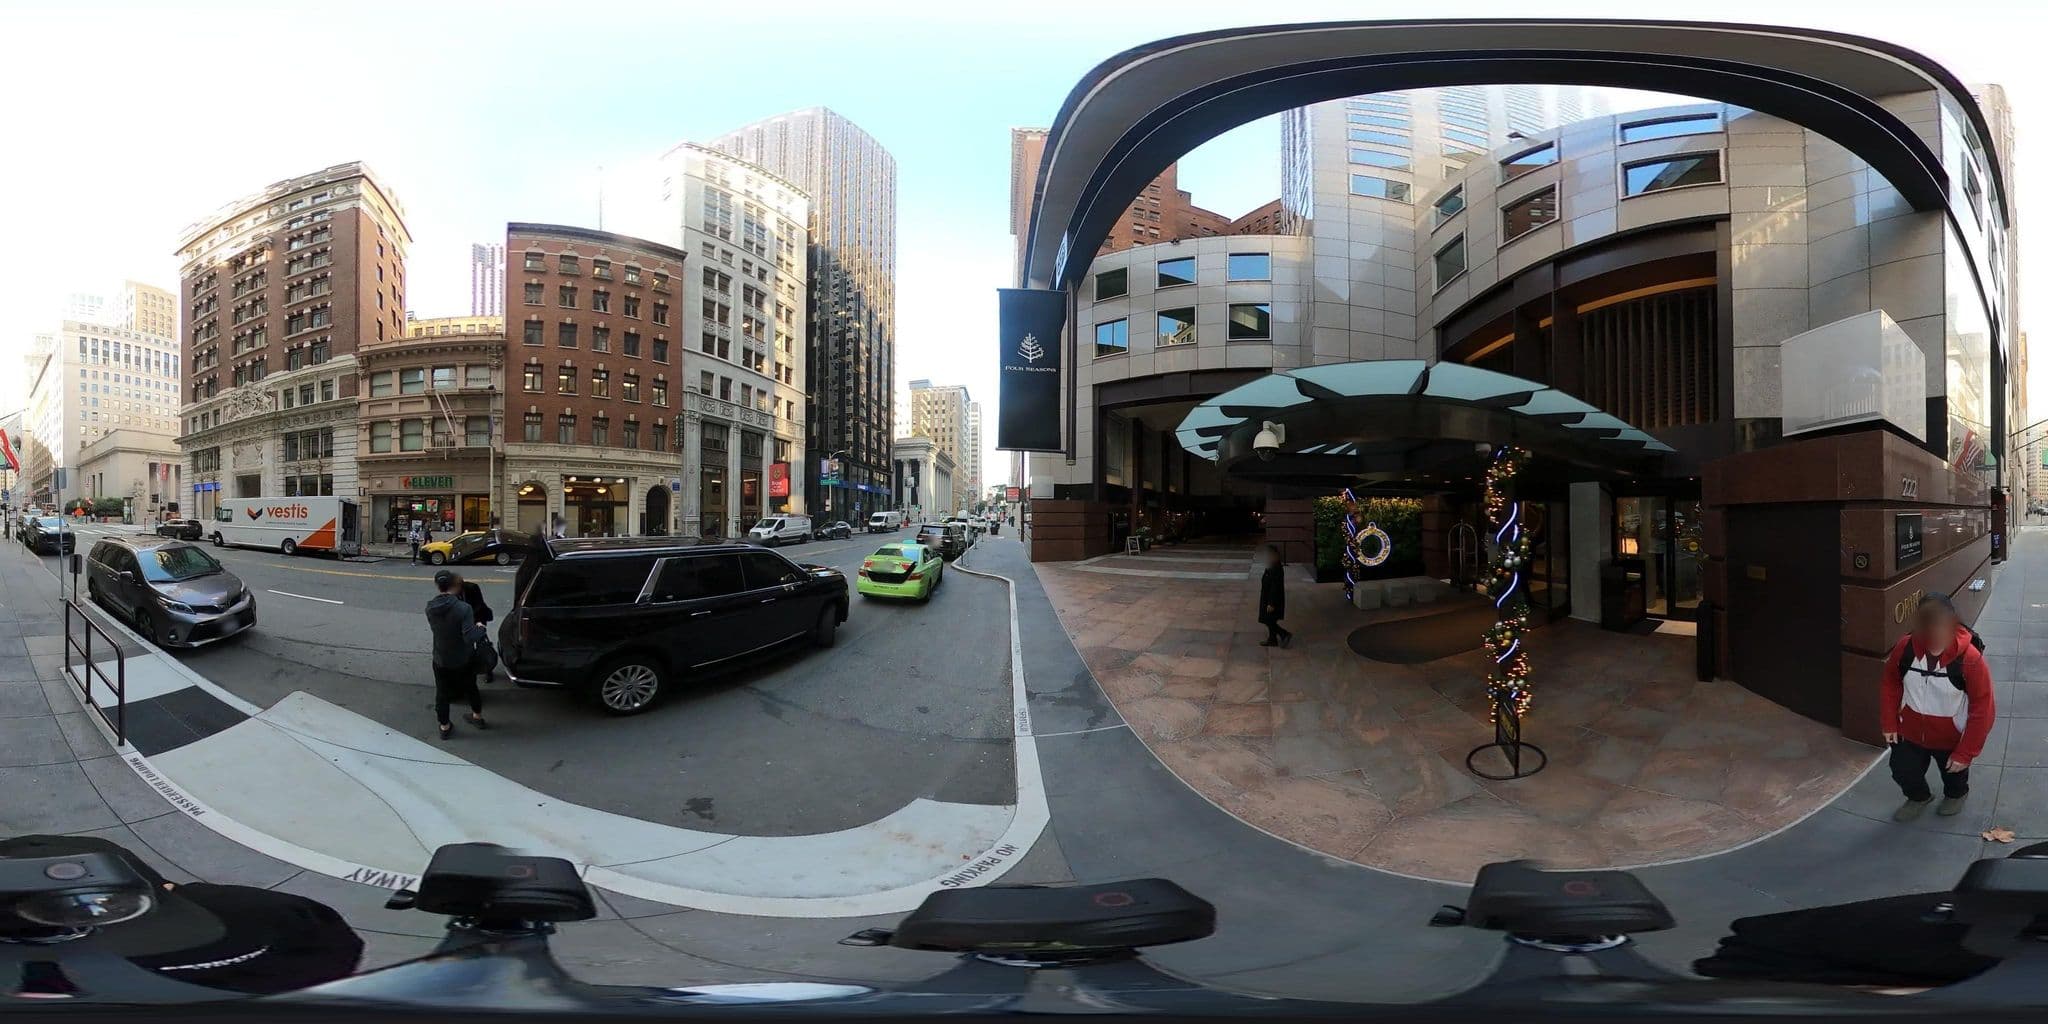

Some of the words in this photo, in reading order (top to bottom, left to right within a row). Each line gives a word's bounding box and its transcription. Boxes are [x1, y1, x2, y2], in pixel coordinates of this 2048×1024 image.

[1902, 477, 1918, 497] 222
[266, 503, 308, 519] vestis
[154, 780, 206, 816] PASSENGER
[995, 844, 1019, 857] NO
[344, 868, 417, 890] AWAY
[941, 856, 1002, 887] PARKING
